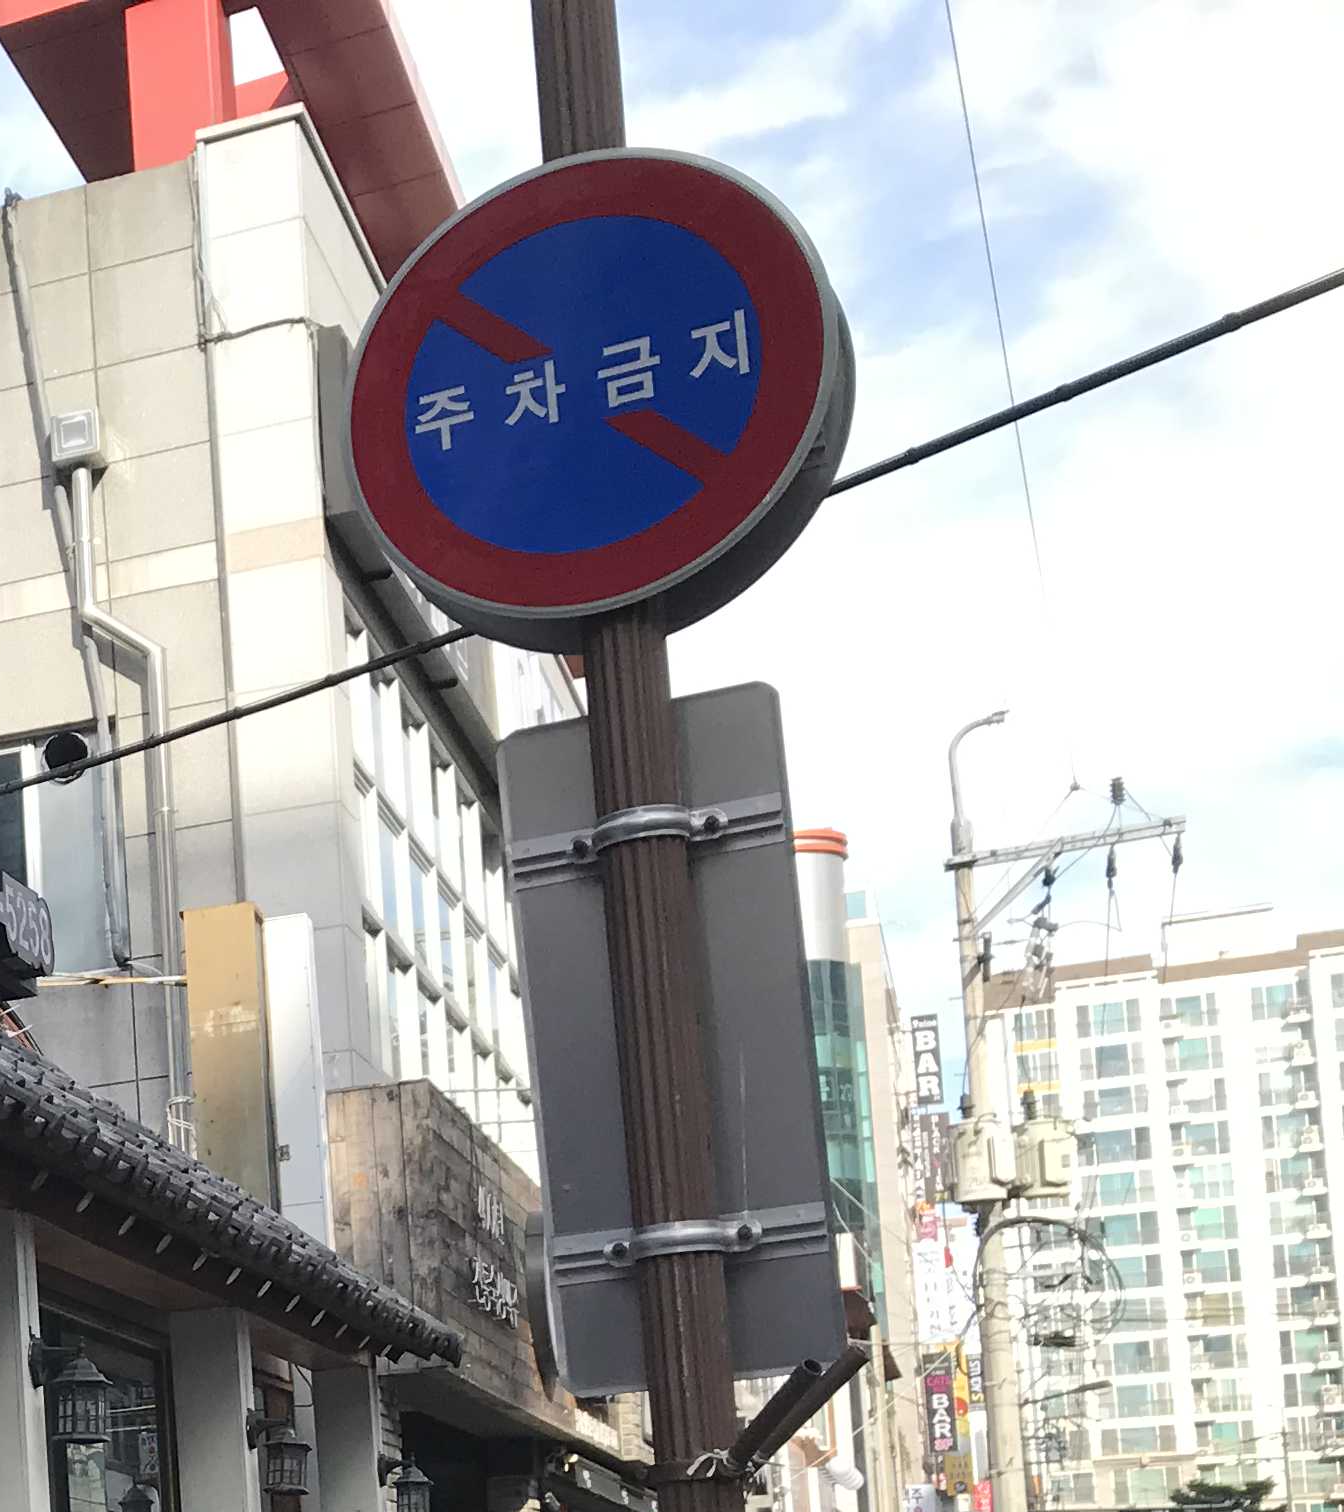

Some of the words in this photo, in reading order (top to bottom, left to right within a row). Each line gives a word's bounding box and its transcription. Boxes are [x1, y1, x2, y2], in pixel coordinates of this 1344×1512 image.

[413, 308, 752, 452] 주차금지
[914, 1029, 940, 1098] BAR
[932, 1393, 952, 1439] BAR
